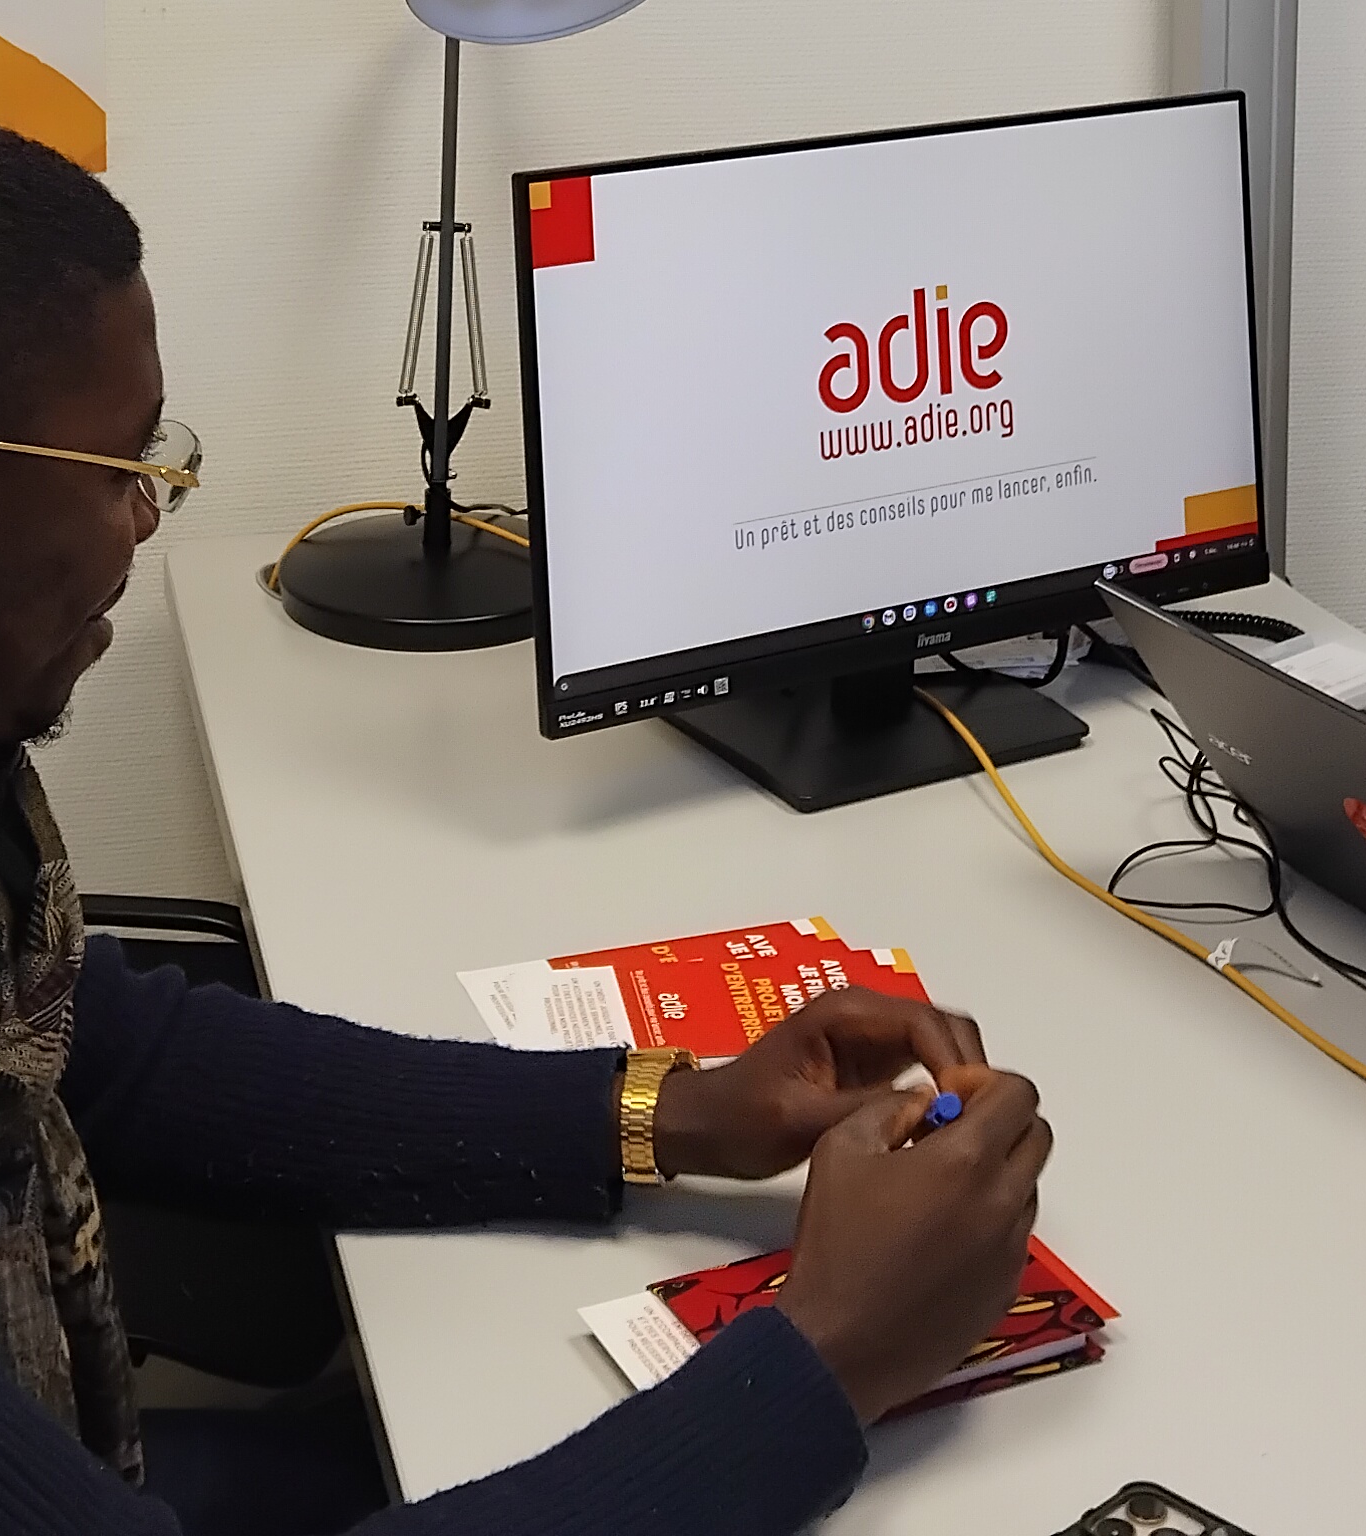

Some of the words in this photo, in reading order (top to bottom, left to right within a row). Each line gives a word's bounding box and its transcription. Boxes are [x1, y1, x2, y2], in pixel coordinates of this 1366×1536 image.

[818, 284, 1008, 414] adie
[820, 399, 1014, 461] www.adie.org
[735, 529, 755, 551] Un
[761, 519, 799, 550] prêt
[803, 515, 822, 537] et
[826, 511, 855, 533] des
[859, 496, 926, 526] conseils
[930, 488, 966, 518] pour
[971, 485, 994, 506] me
[997, 474, 1051, 501] lancer,
[1055, 464, 1098, 490] enfin.
[657, 992, 688, 1020] adie
